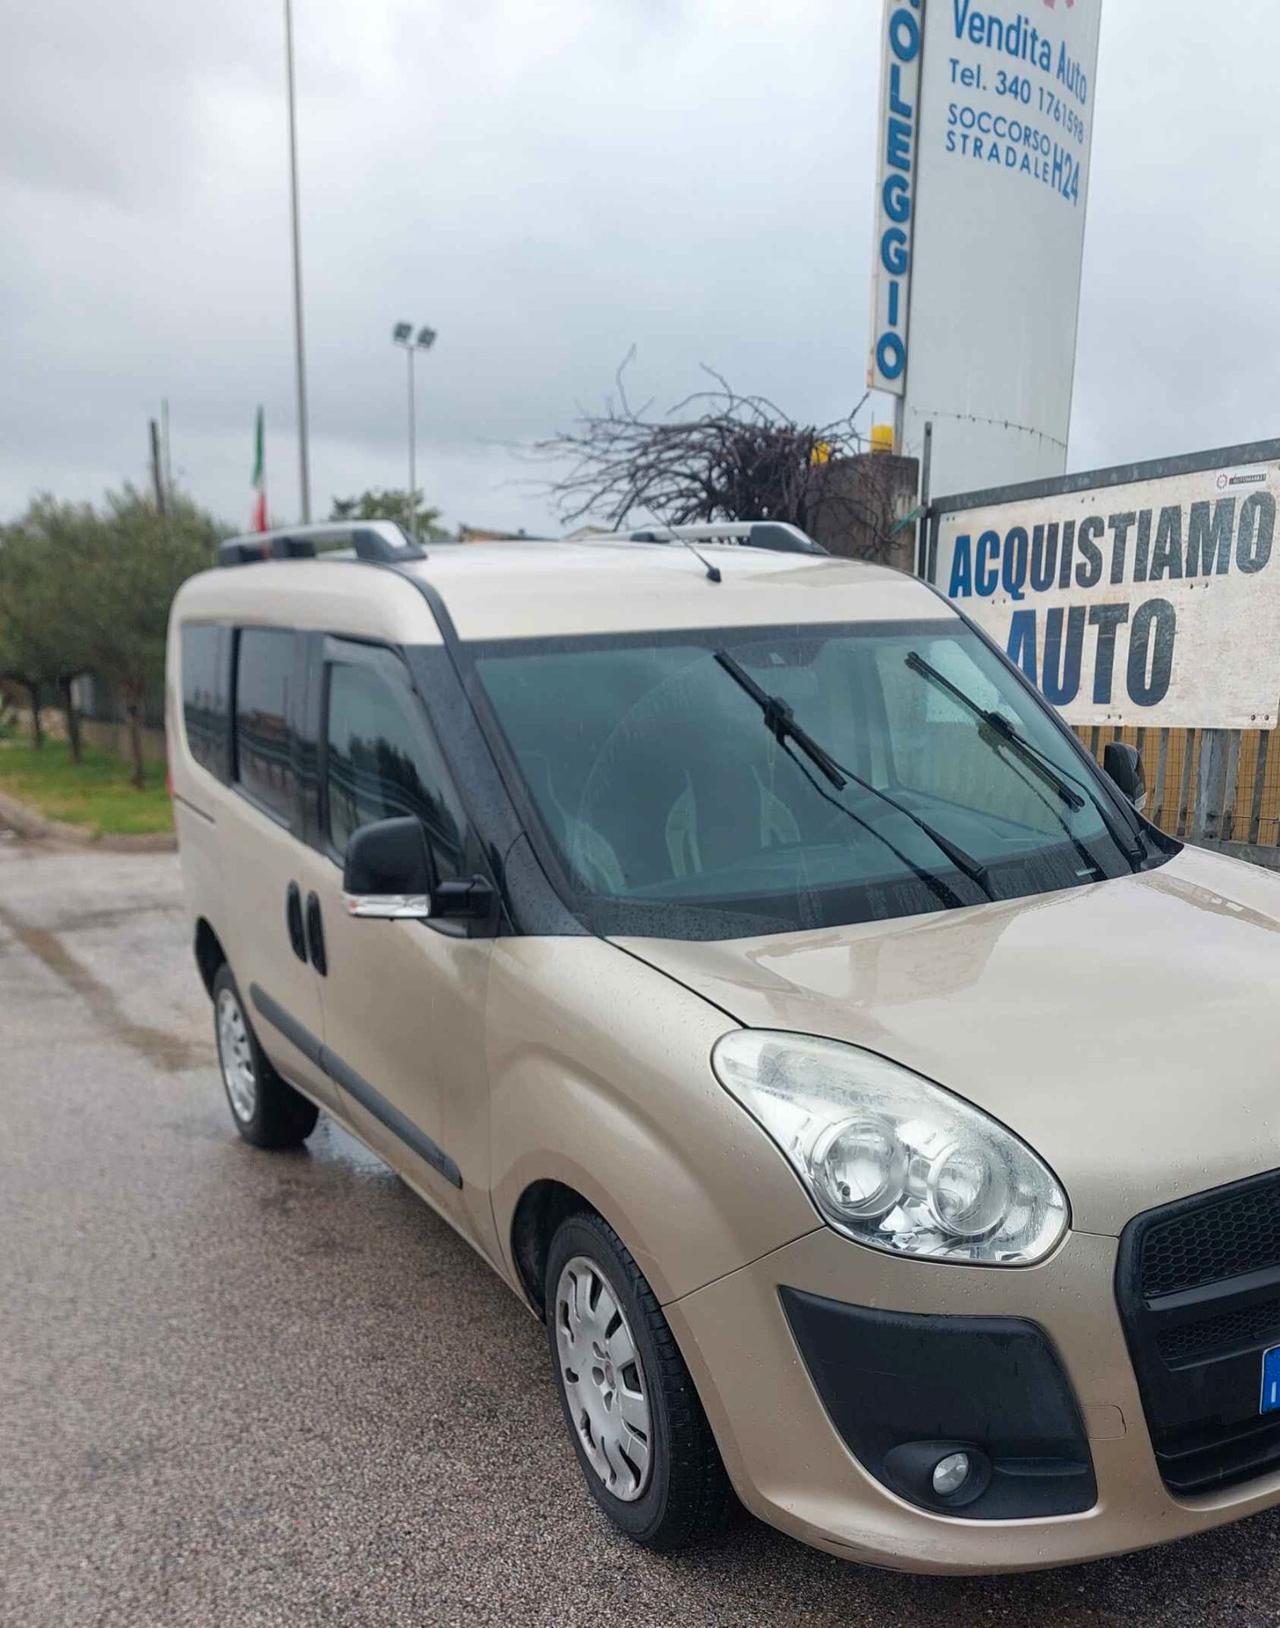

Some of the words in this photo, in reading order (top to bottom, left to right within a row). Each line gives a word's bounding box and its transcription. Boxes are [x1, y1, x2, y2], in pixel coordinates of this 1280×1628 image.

[949, 58, 988, 91] Tel.
[995, 70, 1031, 104] 340
[1039, 86, 1084, 145] 1761598
[952, 0, 1051, 72] Vendita
[1056, 40, 1087, 105] Auto
[946, 130, 1049, 183] STRADALE
[1051, 142, 1080, 206] H24
[947, 103, 1050, 157] SOCCORSO
[876, 0, 921, 380] OLEGGIO
[948, 491, 1277, 600] ACQUISTIAMO
[1006, 598, 1176, 706] AUTO
